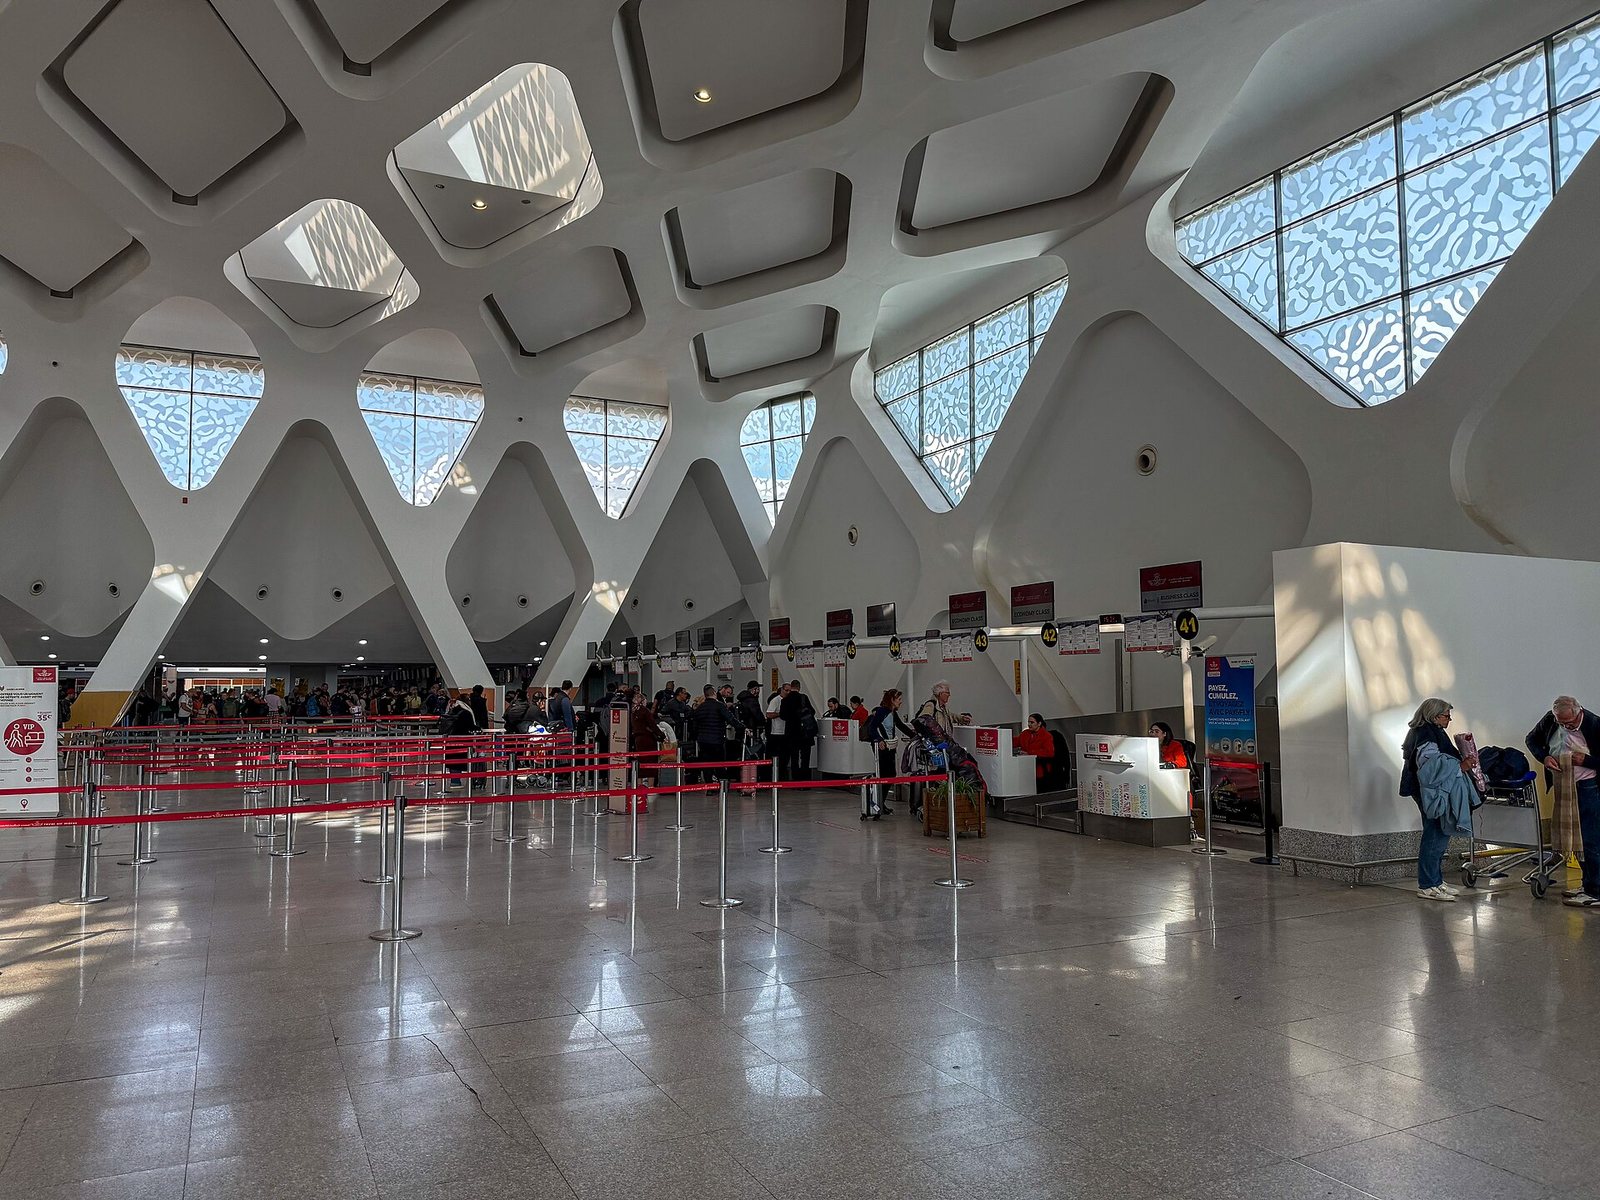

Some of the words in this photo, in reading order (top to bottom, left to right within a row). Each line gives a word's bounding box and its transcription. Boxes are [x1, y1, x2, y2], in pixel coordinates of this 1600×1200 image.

[1160, 593, 1183, 601] BUSINESS
[1183, 591, 1199, 599] CLASS
[1036, 608, 1050, 616] CLASS
[1179, 618, 1198, 633] 41
[1043, 628, 1056, 642] 42
[975, 635, 987, 648] 43
[847, 645, 856, 655] 45
[890, 642, 899, 652] 44
[1208, 684, 1228, 692] PAYEZ,
[1208, 692, 1239, 700] CUMULEZ,
